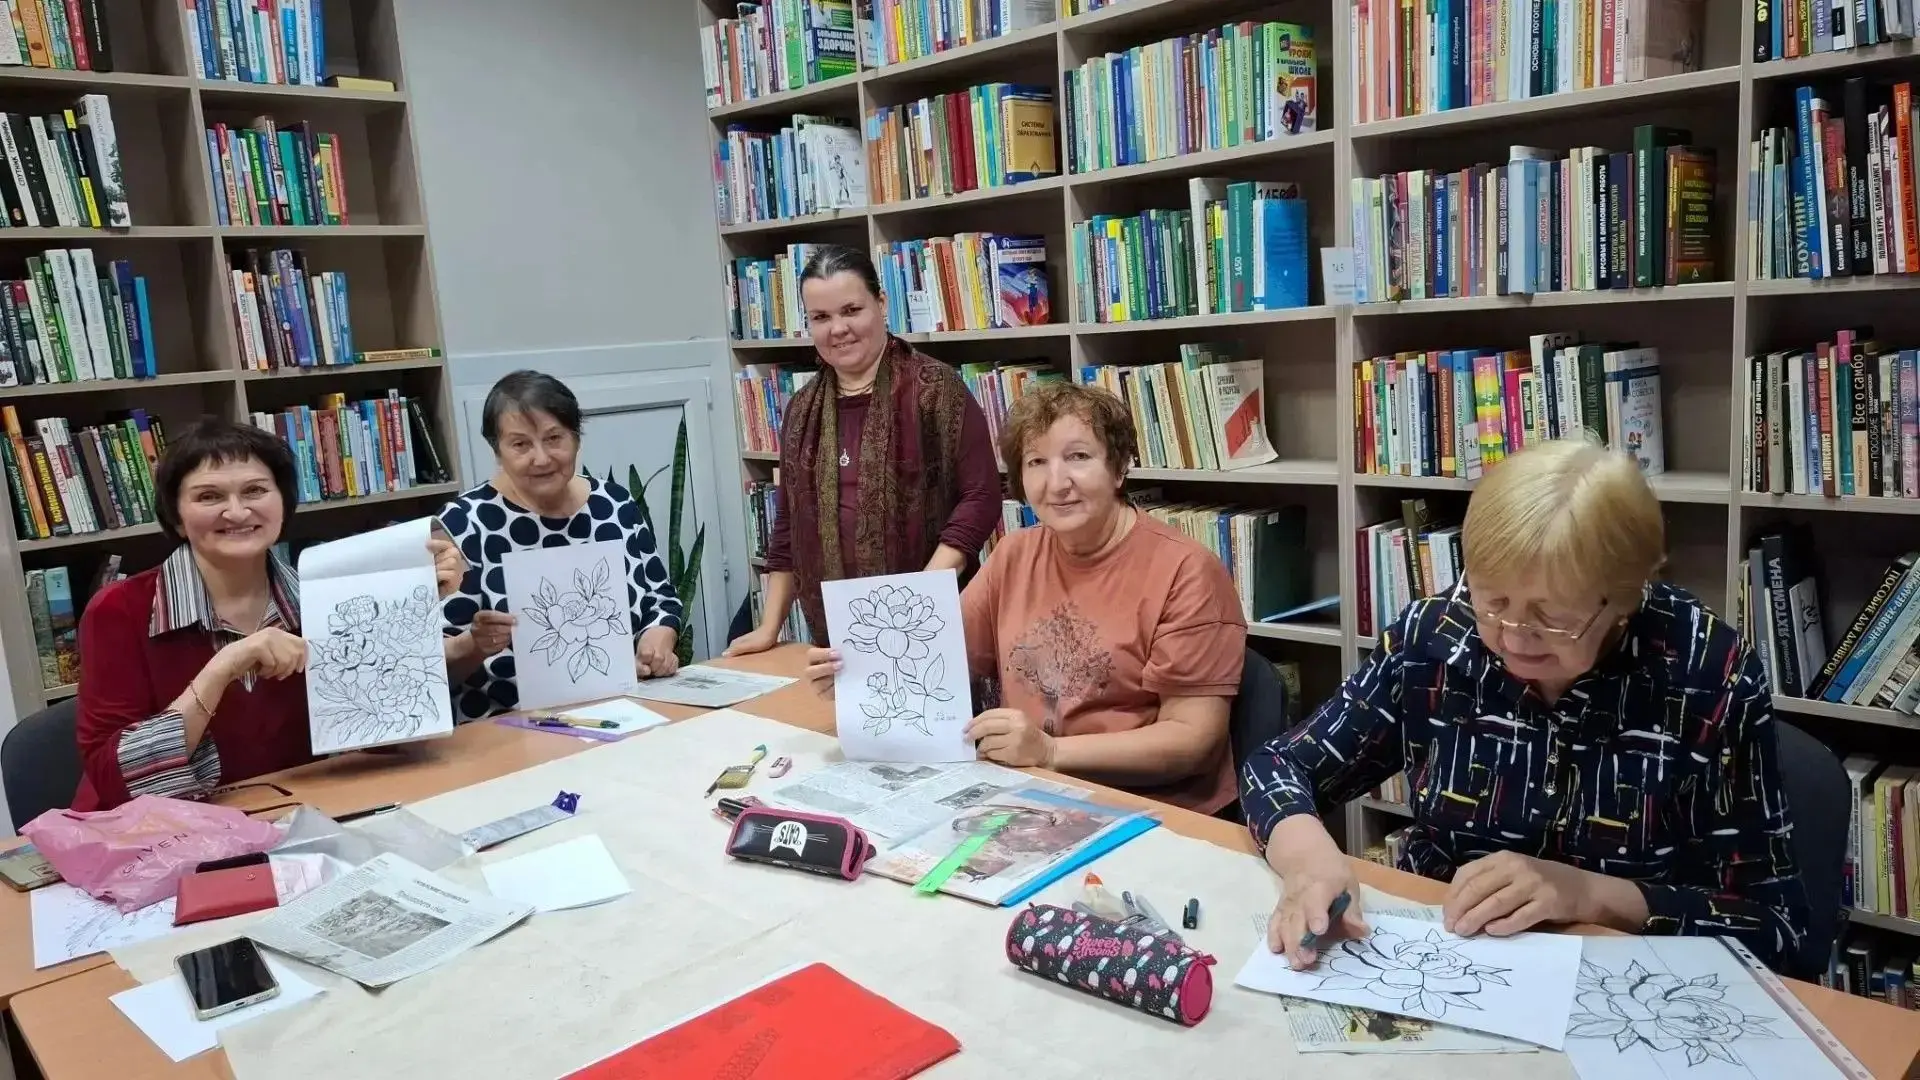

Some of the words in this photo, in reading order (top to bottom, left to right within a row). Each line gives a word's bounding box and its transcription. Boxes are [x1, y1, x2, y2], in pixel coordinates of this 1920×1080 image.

[1288, 66, 1312, 76] ШКОЛЕ
[1531, 38, 1540, 72] ОСНОВЫ
[1598, 164, 1607, 192] РАБОТЫ
[1793, 192, 1810, 275] БОУЛИНГ
[1817, 357, 1829, 370] 100
[1849, 353, 1865, 391] самбо
[1855, 392, 1865, 401] о
[1852, 403, 1866, 425] Все
[1754, 415, 1764, 449] БОКС
[1869, 416, 1880, 459] ПОСОБИЕ
[1821, 433, 1832, 481] САМОЗАЩИТЫ
[41, 483, 63, 524] ЦВЕТОВОДСТВО
[1768, 556, 1791, 638] ЯХТСМЕНА
[1865, 569, 1901, 614] ПОСОБИЕ
[1853, 613, 1869, 634] ДЛЯ
[1822, 631, 1857, 677] ДАЙВЕРОВ
[778, 823, 802, 846] CATS
